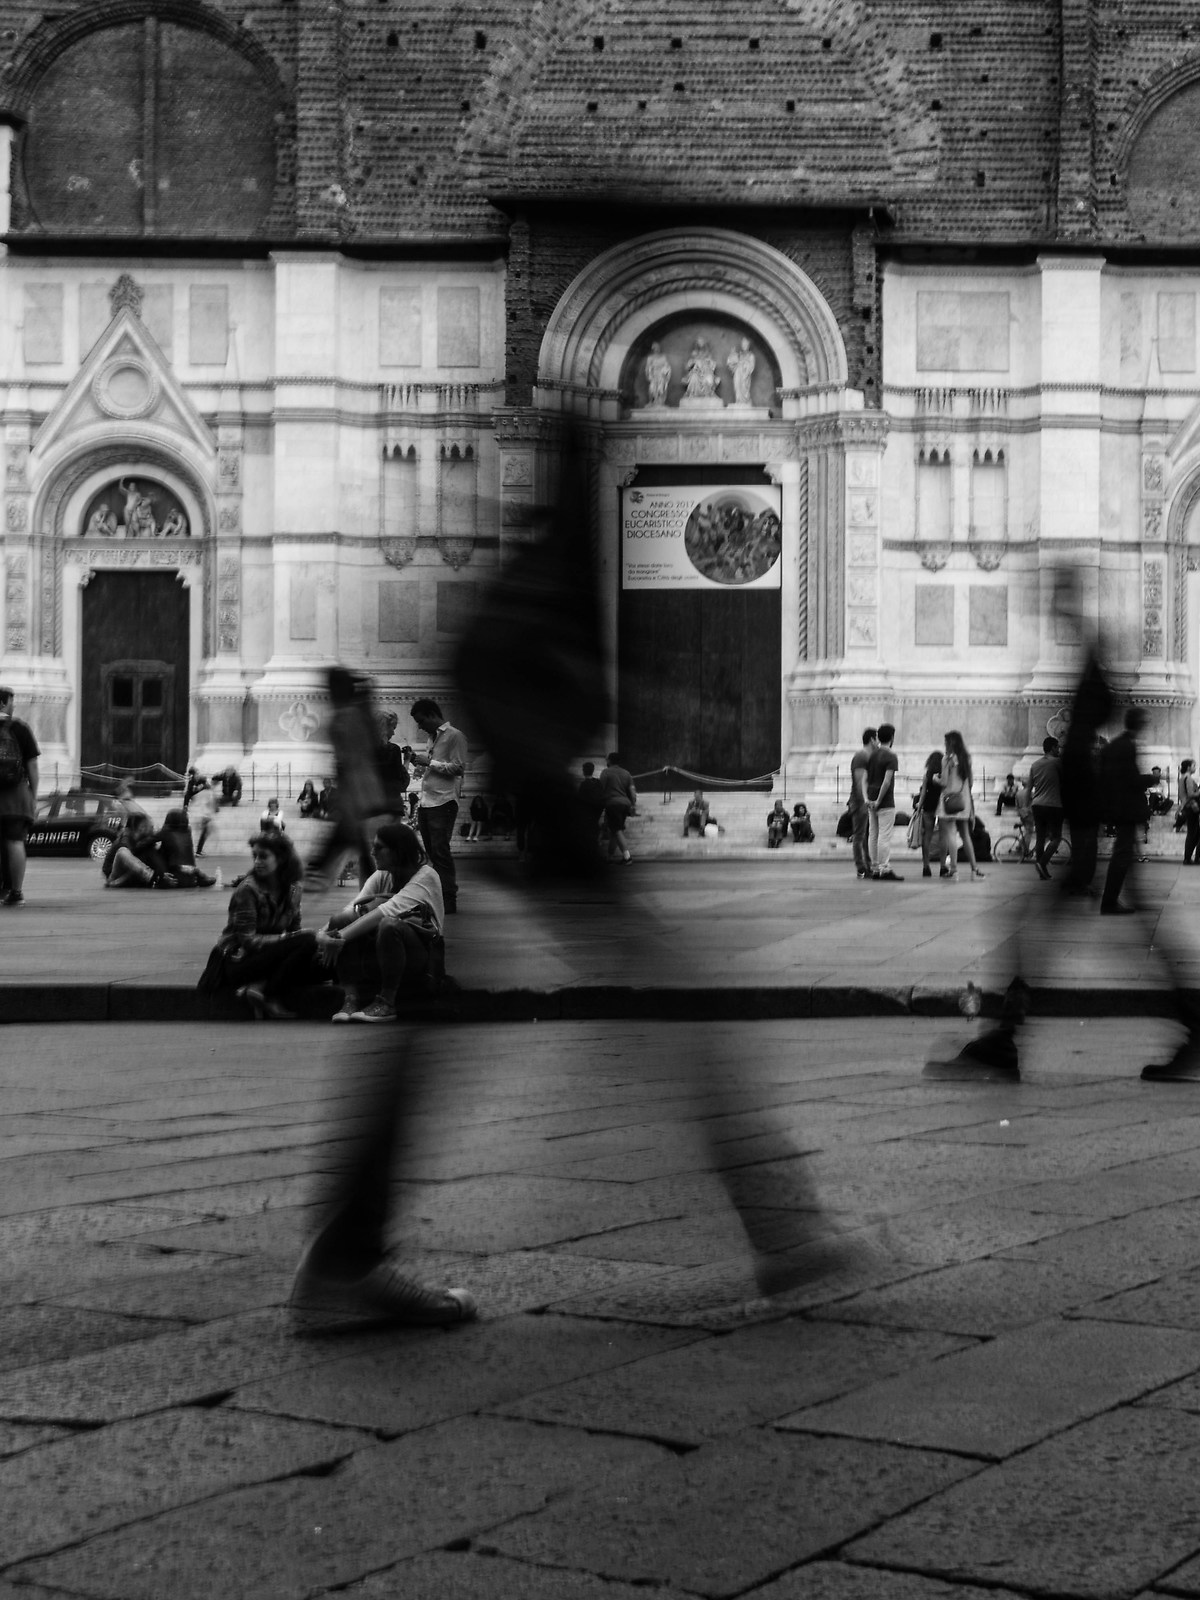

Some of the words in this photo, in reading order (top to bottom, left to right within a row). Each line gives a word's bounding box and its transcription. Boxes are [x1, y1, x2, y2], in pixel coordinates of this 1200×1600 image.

[649, 501, 674, 509] ANNO
[676, 500, 695, 508] 2017
[630, 509, 689, 519] CONGRESSO
[624, 519, 684, 529] EUCARISTICO
[626, 529, 682, 539] DIOCESANO
[107, 817, 122, 827] 112
[26, 831, 80, 843] ABINIERI
